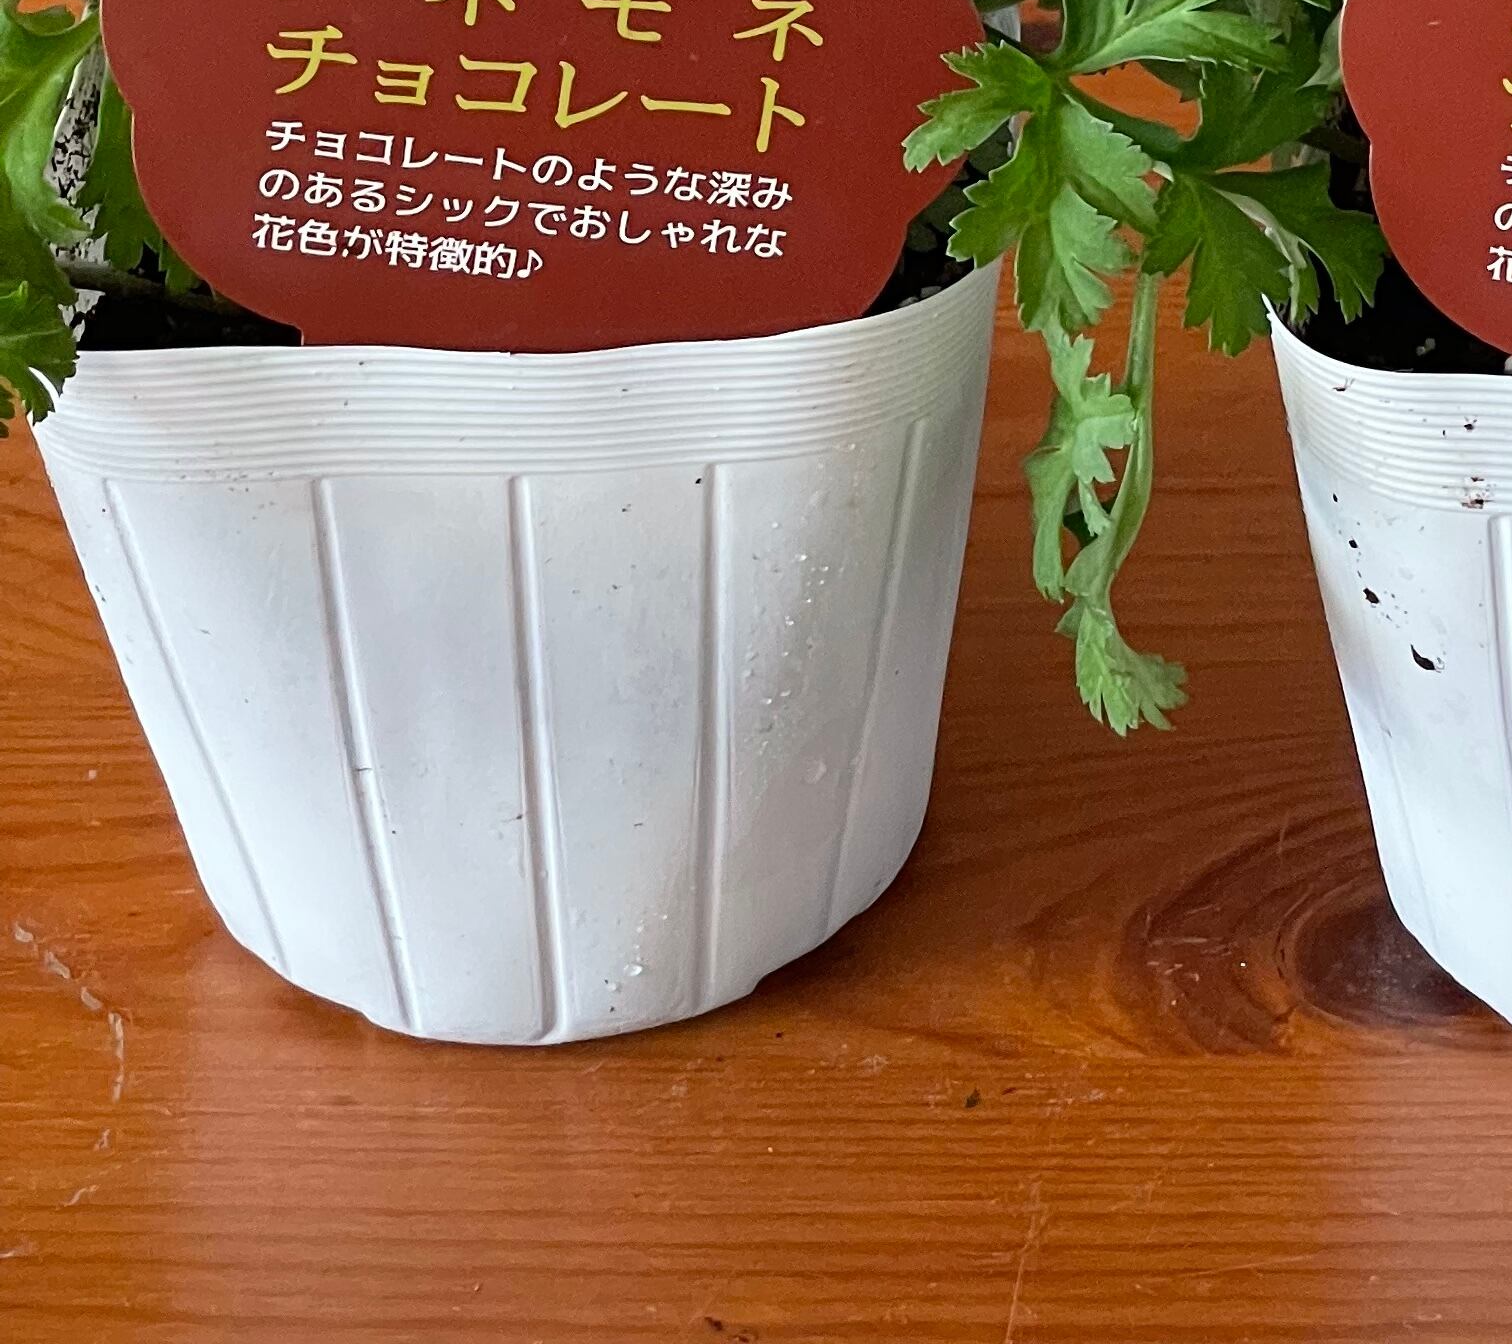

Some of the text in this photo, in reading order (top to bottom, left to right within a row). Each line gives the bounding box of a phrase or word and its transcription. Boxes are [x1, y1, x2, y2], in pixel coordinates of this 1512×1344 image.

[265, 23, 806, 154] チョコレート
[257, 165, 787, 260] のあるシックでおしゃれな
[264, 119, 795, 214] チョコレートのような深み
